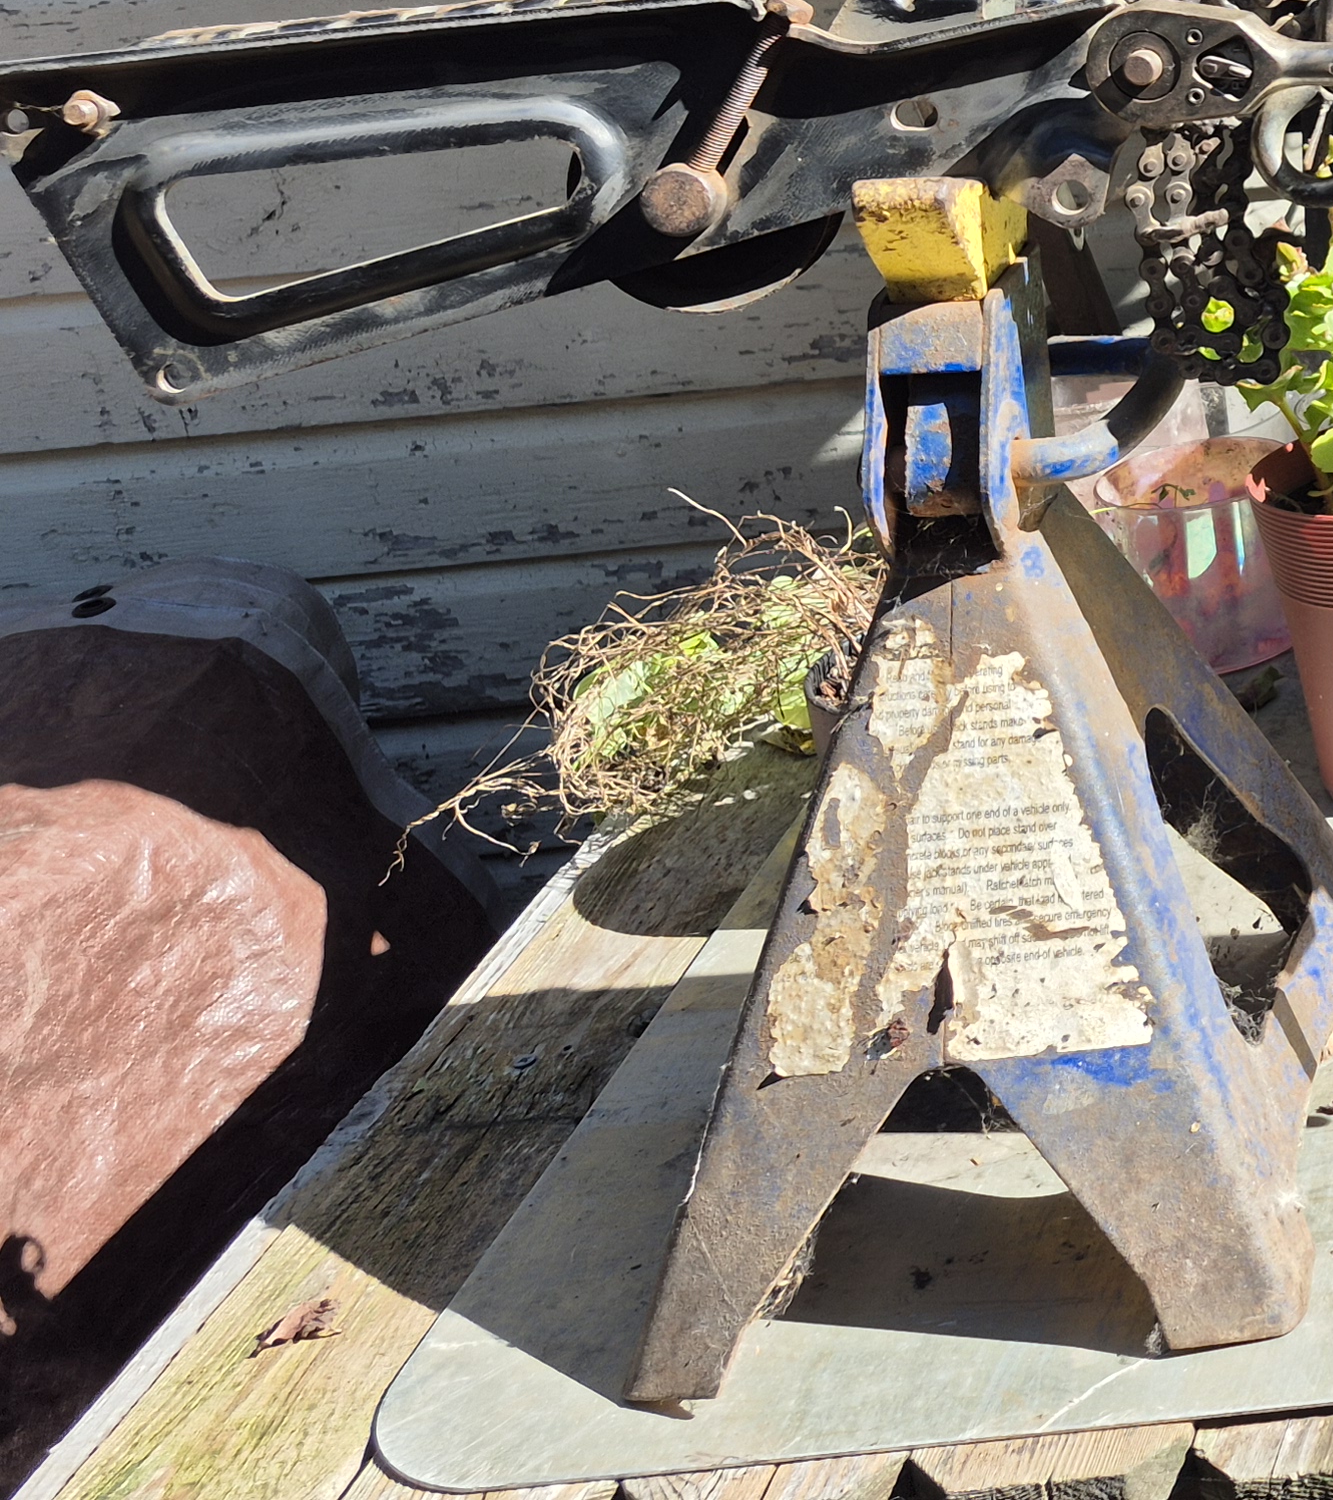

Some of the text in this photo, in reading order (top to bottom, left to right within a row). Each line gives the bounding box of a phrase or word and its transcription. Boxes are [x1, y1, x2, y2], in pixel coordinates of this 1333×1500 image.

[975, 700, 1011, 714] personal
[978, 737, 988, 748] for
[990, 737, 1006, 750] any
[932, 811, 964, 825] support
[967, 809, 982, 820] one
[984, 807, 1000, 819] end
[1003, 805, 1011, 817] of
[1021, 803, 1050, 816] vehicle
[958, 827, 970, 839] Do
[972, 826, 985, 838] not
[988, 824, 1010, 838] place
[1013, 821, 1036, 834] stand
[1038, 819, 1057, 831] over
[973, 862, 998, 875] under
[1001, 858, 1030, 872] vehicle
[970, 899, 981, 911] Be
[1009, 931, 1019, 944] off
